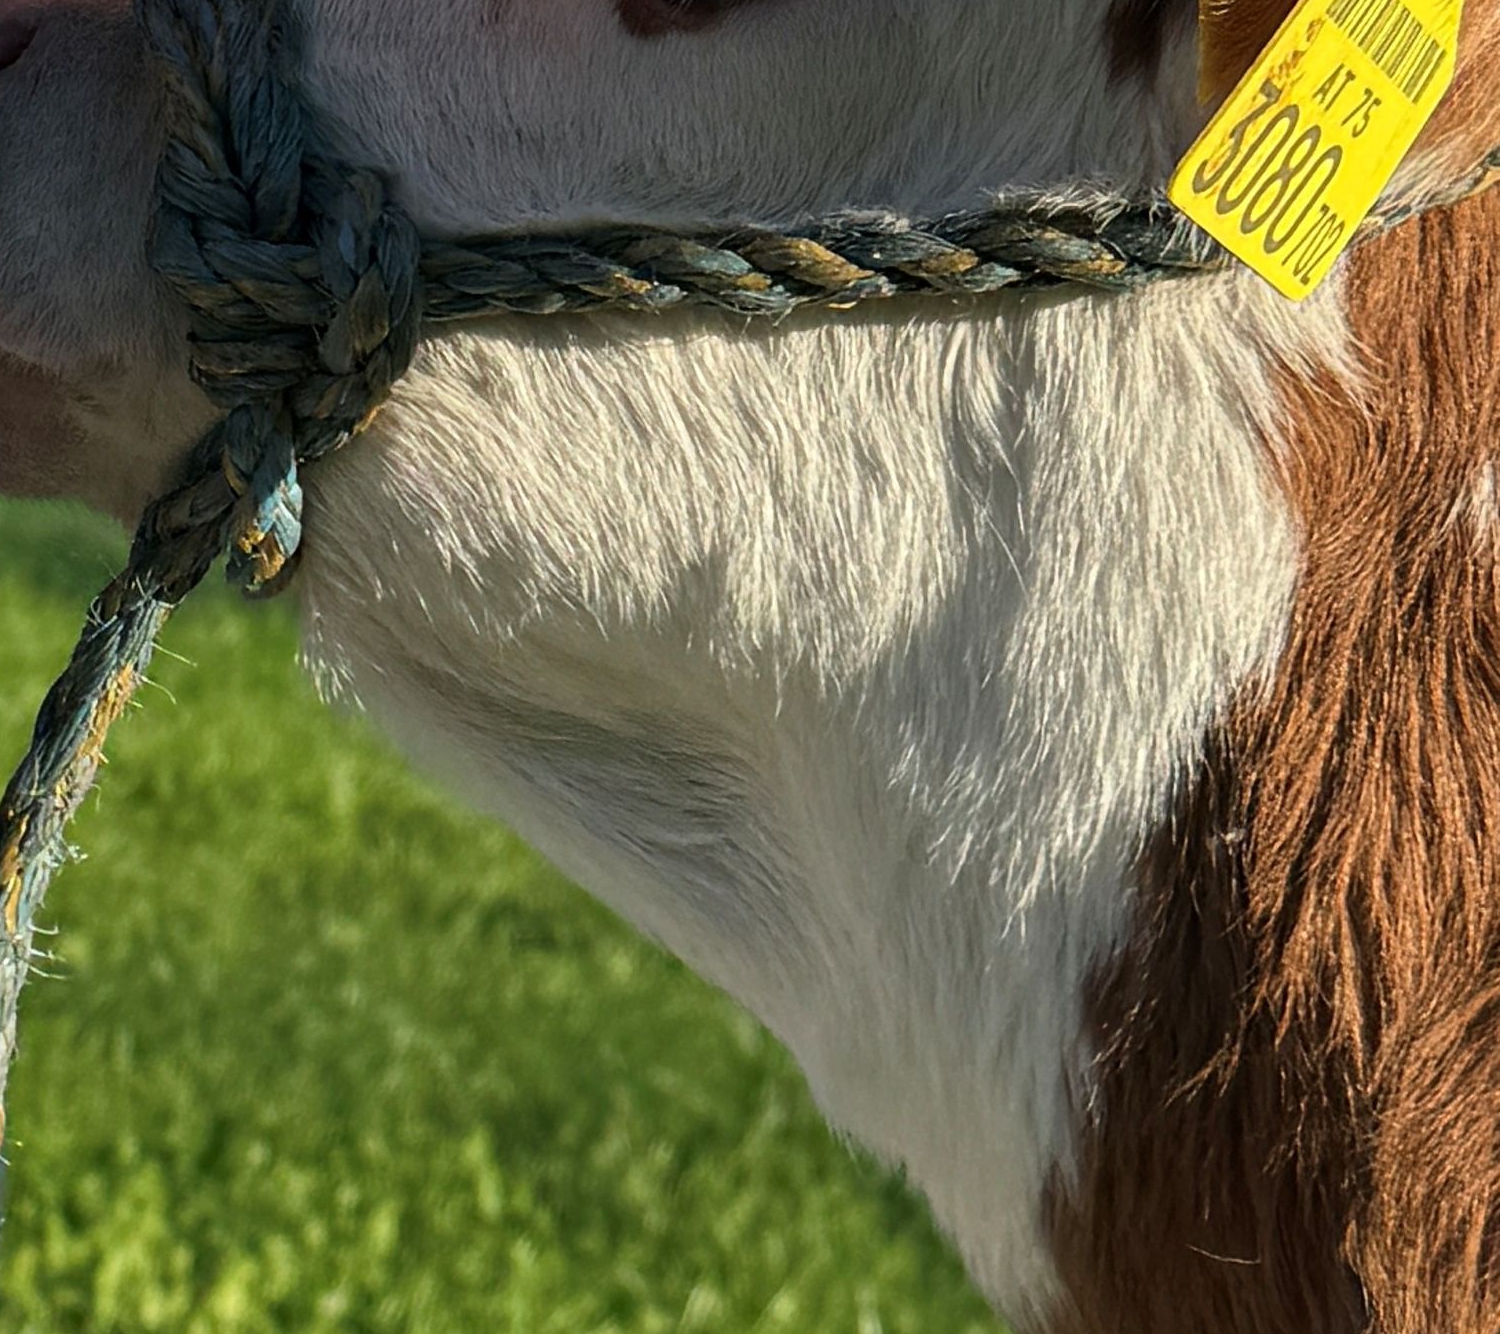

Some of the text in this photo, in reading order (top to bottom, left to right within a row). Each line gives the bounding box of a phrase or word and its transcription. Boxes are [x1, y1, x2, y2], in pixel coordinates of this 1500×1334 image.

[1311, 63, 1382, 139] AT 75
[1281, 201, 1347, 287] 702
